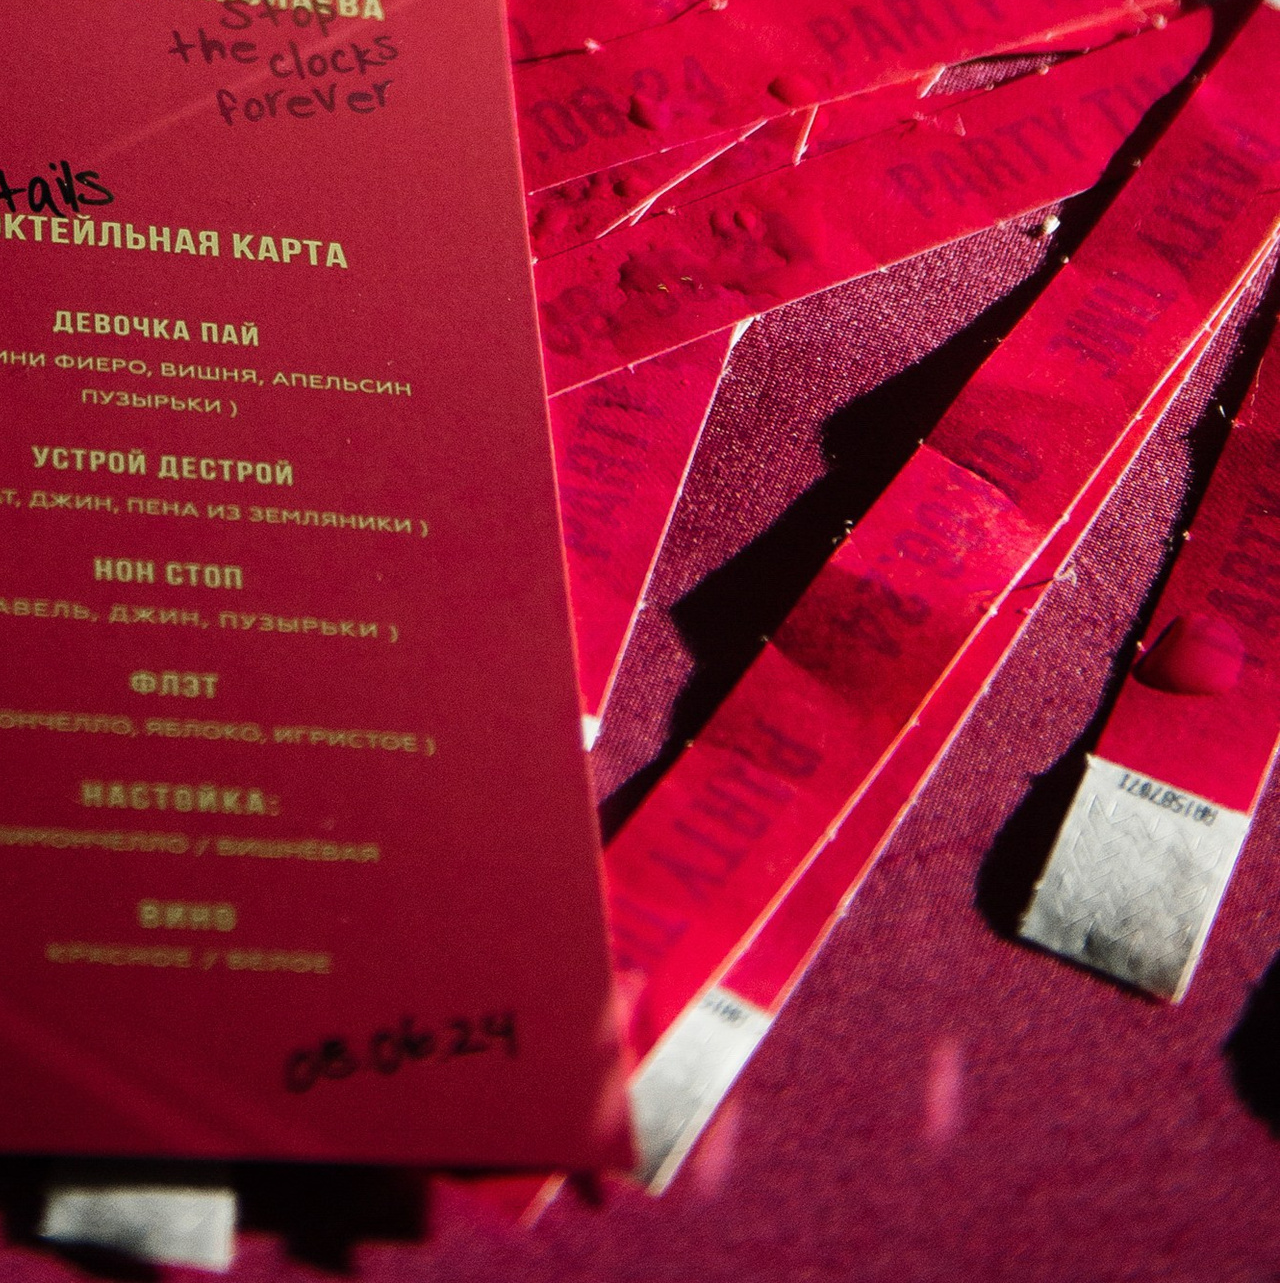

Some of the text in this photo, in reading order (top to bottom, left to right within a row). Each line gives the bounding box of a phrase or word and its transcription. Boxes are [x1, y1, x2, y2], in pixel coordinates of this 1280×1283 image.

[169, 27, 400, 81] the clocks
[215, 78, 395, 127] forever
[885, 104, 1087, 219] PARTY
[231, 232, 349, 270] КАРТА
[52, 309, 260, 347] ДЕВОЧКА ПАЙ
[53, 352, 153, 378] ФИЕРО,
[160, 362, 265, 386] ВИШНЯ,
[272, 371, 413, 397] АПЕЛЬСИН
[81, 387, 223, 414] ПУЗЫРЬКИ
[31, 444, 295, 487] УСТРОЙ ДЕСТРОЙ
[27, 490, 121, 514] ДЖИН,
[126, 497, 200, 519] ПЕНА
[206, 503, 243, 522] ИЗ
[249, 505, 414, 534] ЗЕМЛЯНИКИ
[93, 556, 245, 591] НОН СТОП
[107, 603, 210, 629] ДЖИН,
[218, 609, 381, 638] ПУЗЫРЬКИ
[128, 669, 220, 700] ФЛЭТ
[272, 724, 419, 753] ИГРИСТОЕ
[78, 778, 281, 817] НАСТОЙКА:
